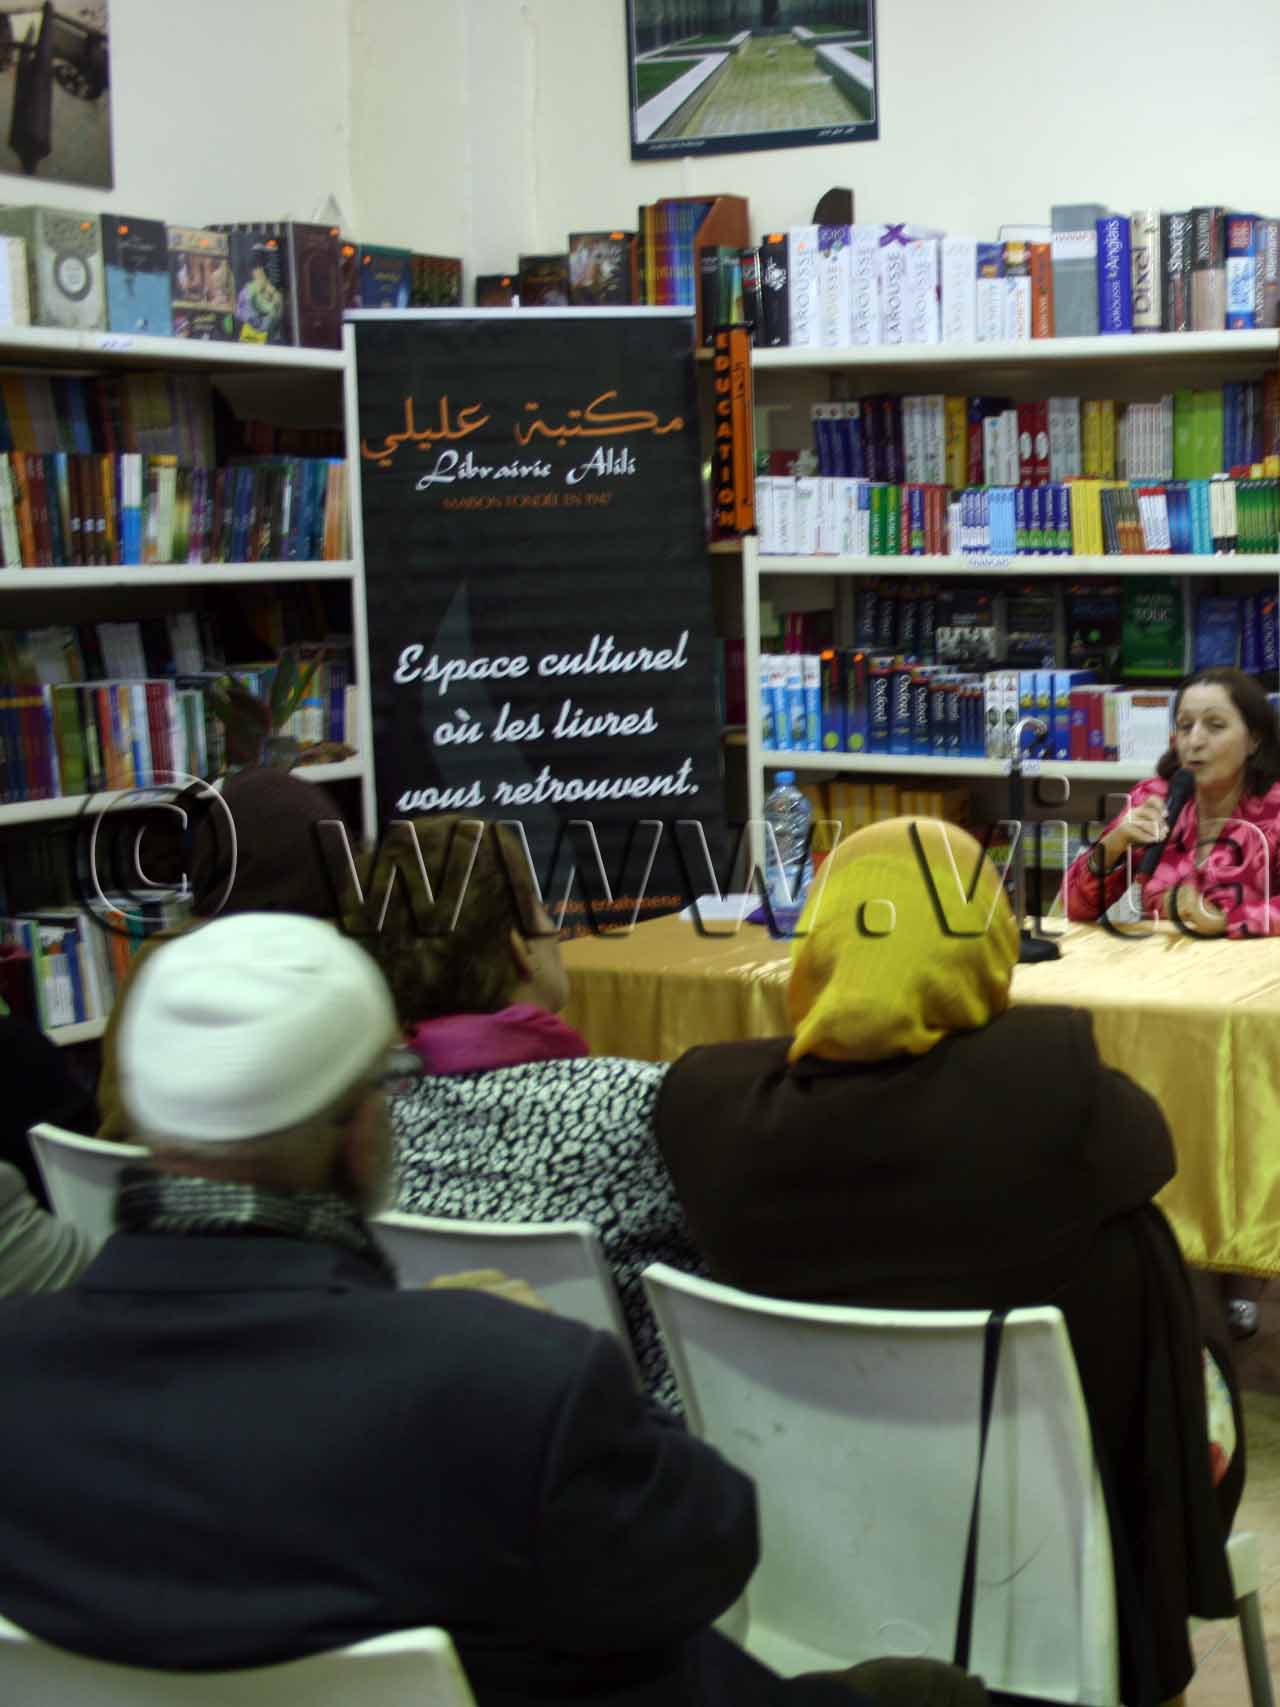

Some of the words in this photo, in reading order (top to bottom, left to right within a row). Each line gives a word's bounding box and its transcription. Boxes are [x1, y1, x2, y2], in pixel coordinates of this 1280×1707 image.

[886, 254, 902, 345] LAROUSSE
[362, 396, 490, 467] عليلي
[513, 391, 684, 447] مكتبة
[714, 332, 736, 527] EDUCATION
[415, 449, 552, 490] Librairie
[565, 445, 637, 484] Alili
[394, 644, 529, 696] Espace
[538, 630, 688, 676] culturel
[433, 708, 483, 745] où
[491, 702, 544, 742] les
[552, 699, 658, 738] livres
[875, 677, 888, 722] Oxford
[897, 673, 911, 719] Oxford
[396, 781, 485, 811] vous
[493, 758, 698, 805] retrouvent.
